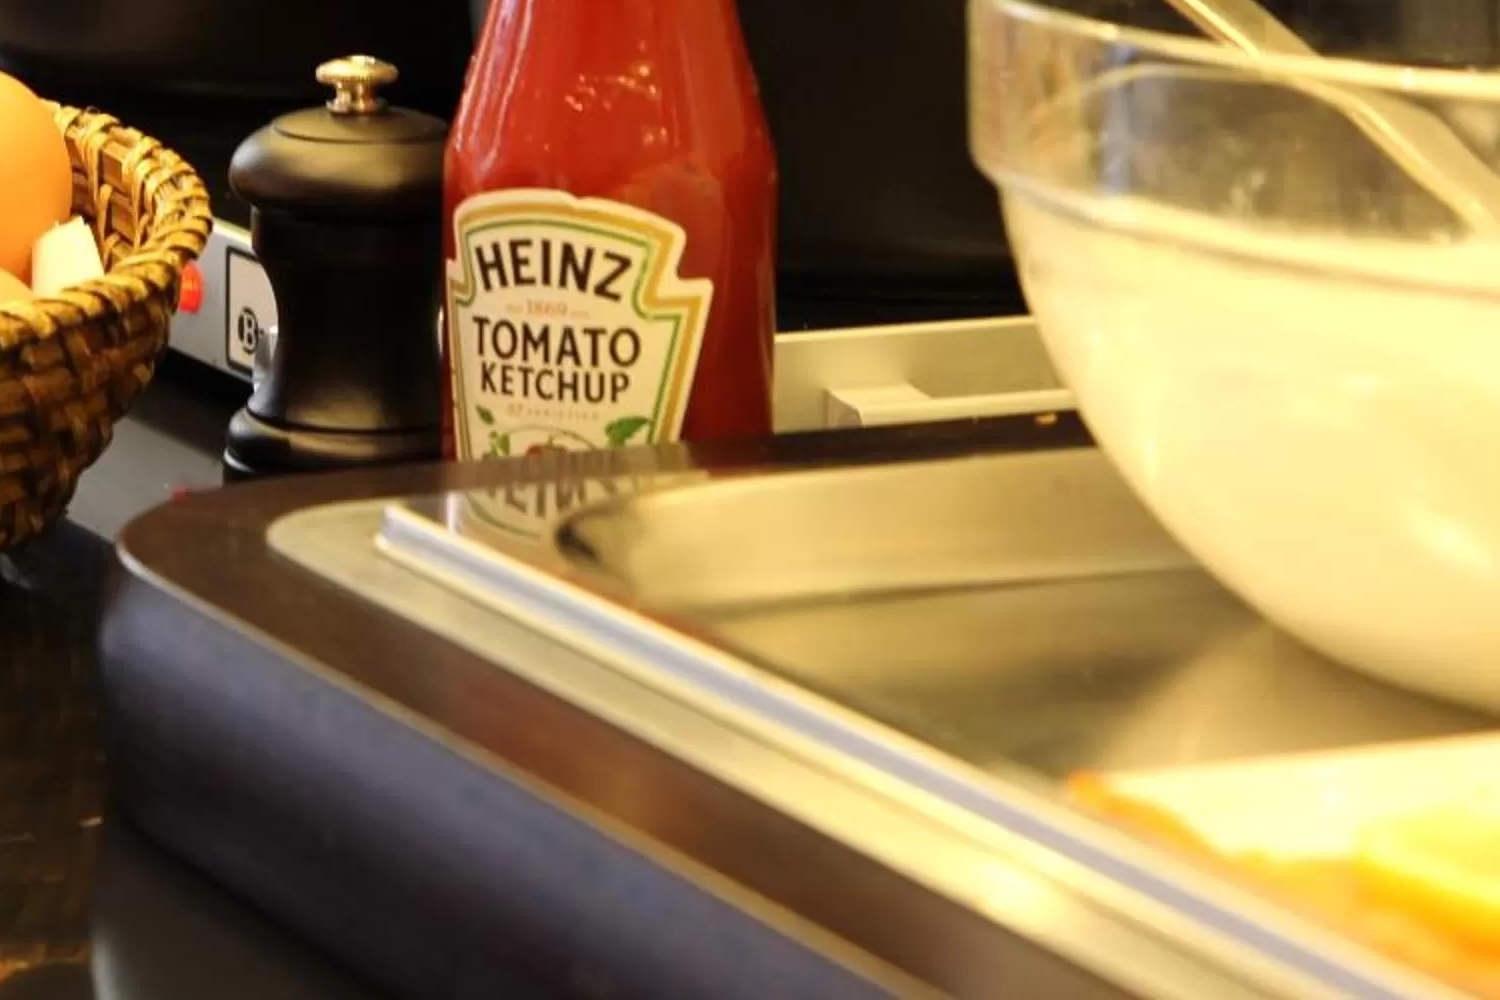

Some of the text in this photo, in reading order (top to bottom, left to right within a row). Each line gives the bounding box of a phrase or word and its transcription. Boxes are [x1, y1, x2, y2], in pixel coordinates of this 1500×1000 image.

[474, 238, 632, 302] HEINZ
[472, 315, 642, 369] TOMATO
[480, 361, 630, 404] KETCHUP
